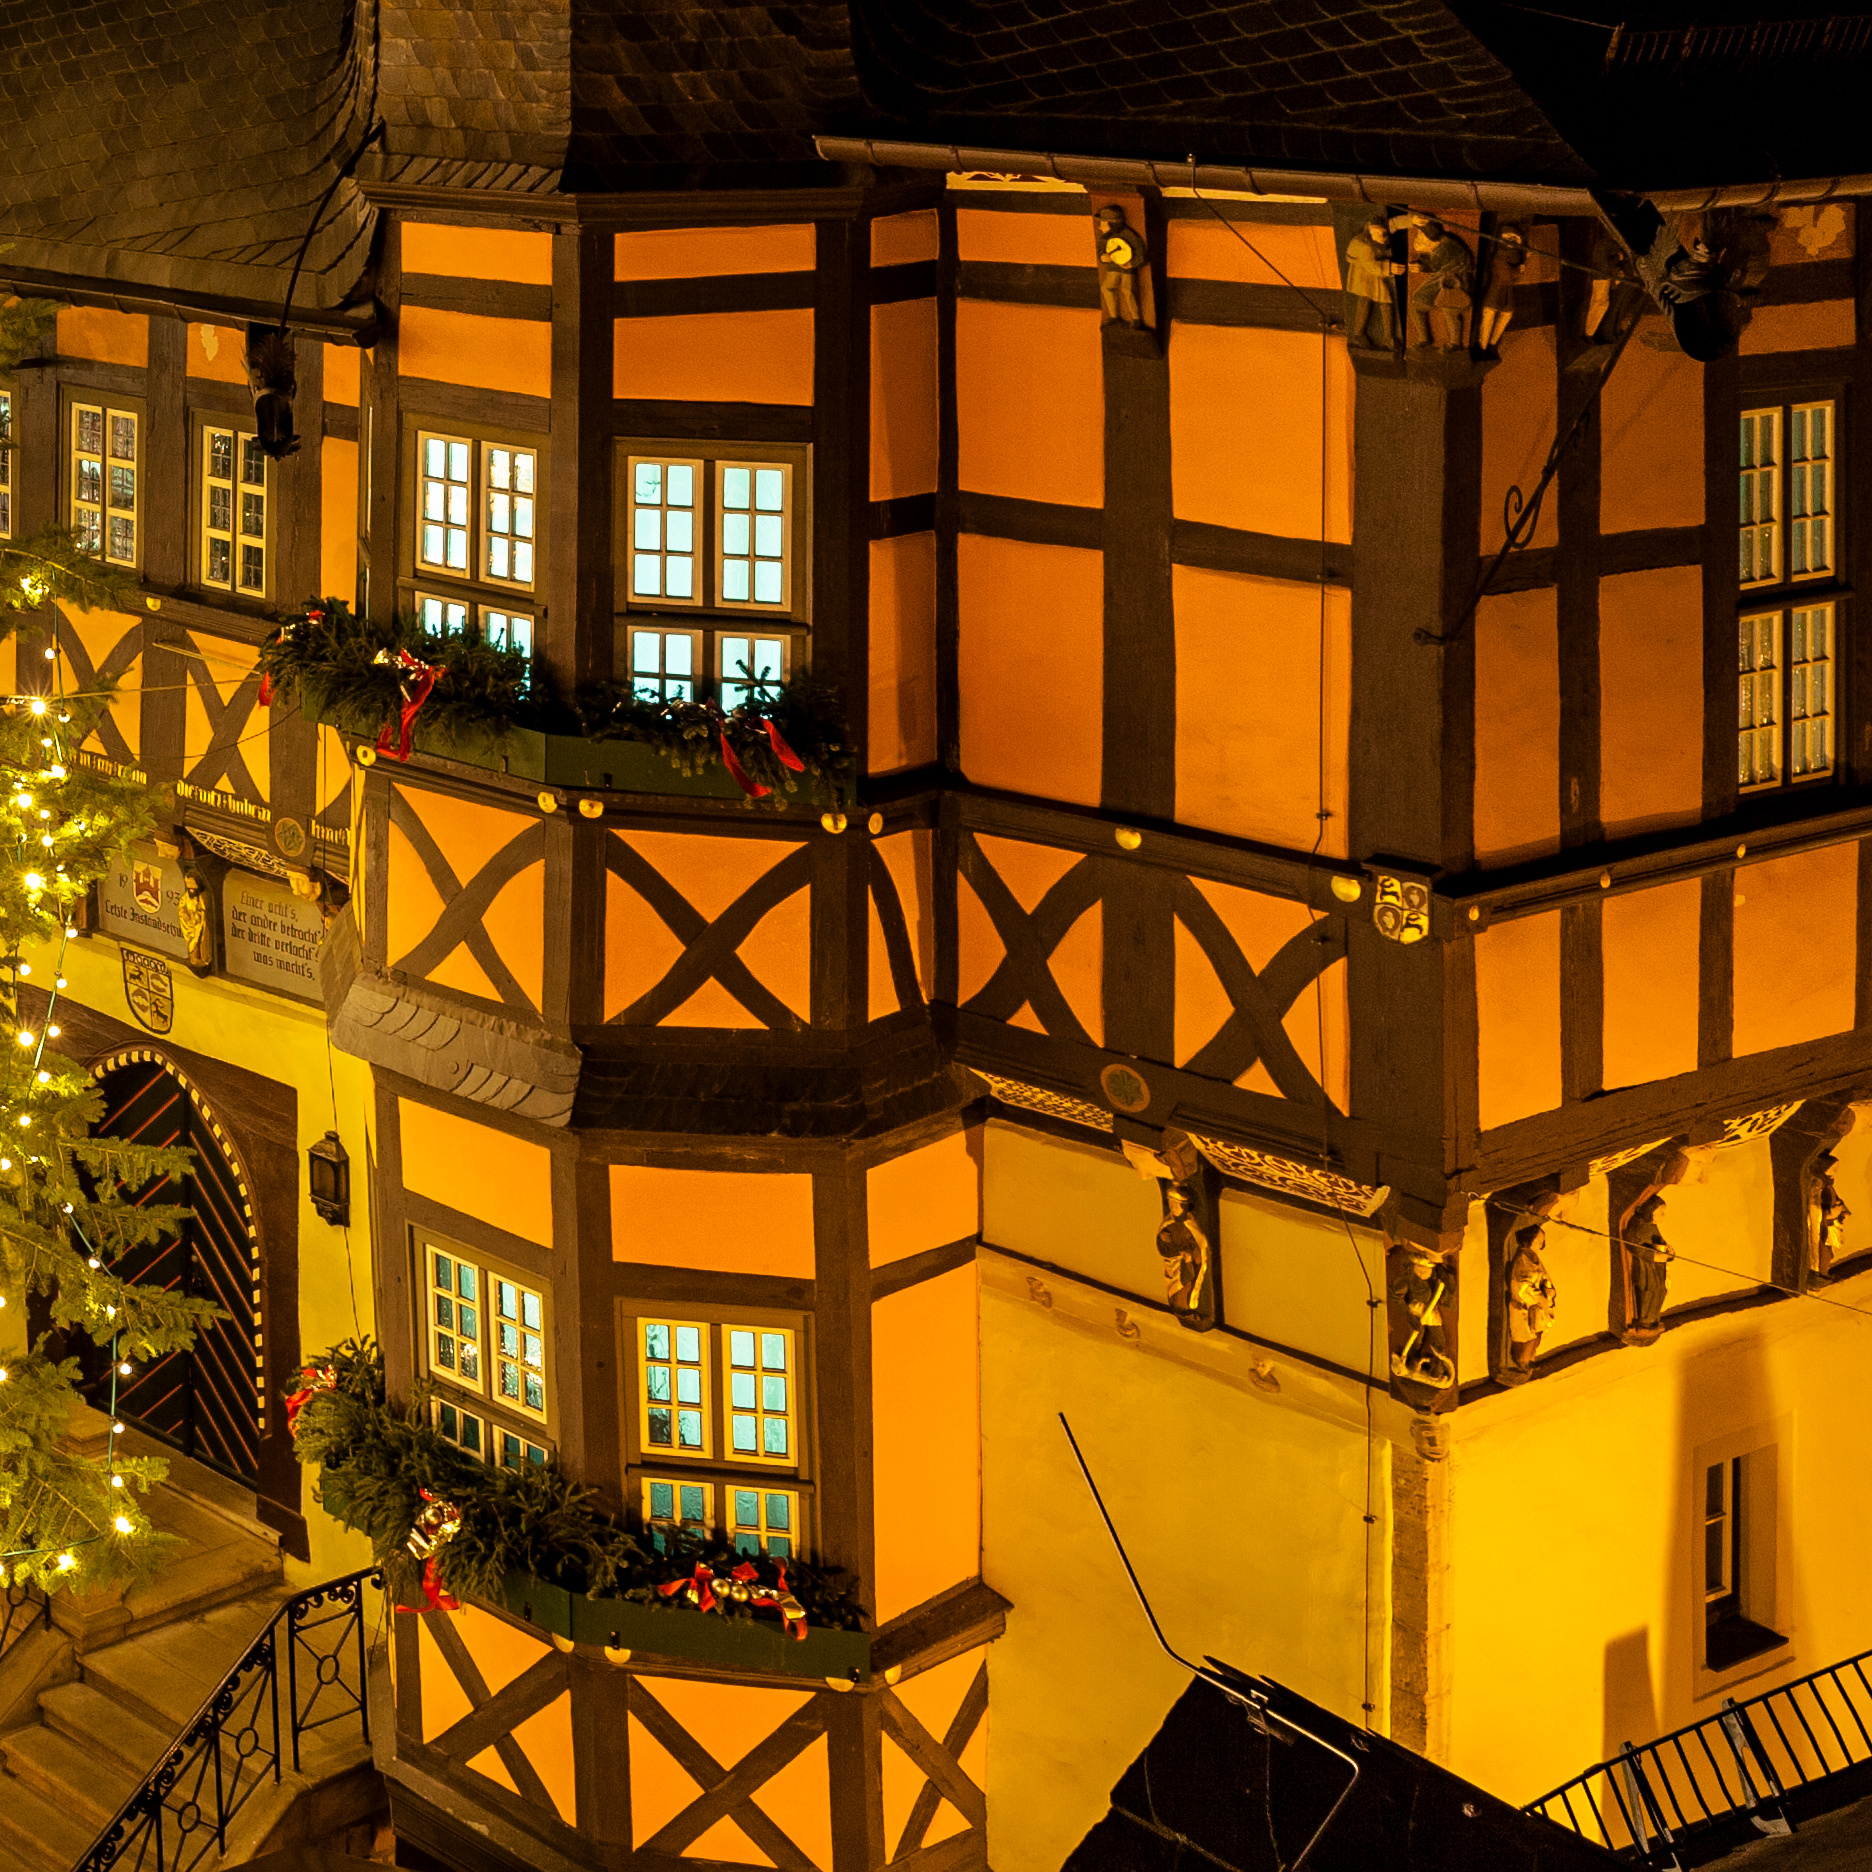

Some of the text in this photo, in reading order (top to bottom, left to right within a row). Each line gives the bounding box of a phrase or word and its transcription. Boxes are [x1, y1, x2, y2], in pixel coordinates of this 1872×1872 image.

[119, 873, 129, 888] 19
[241, 891, 264, 910] Einer
[232, 905, 321, 945] der andre betracht'
[231, 922, 246, 939] der
[247, 927, 271, 948] dritte
[253, 951, 274, 967] was
